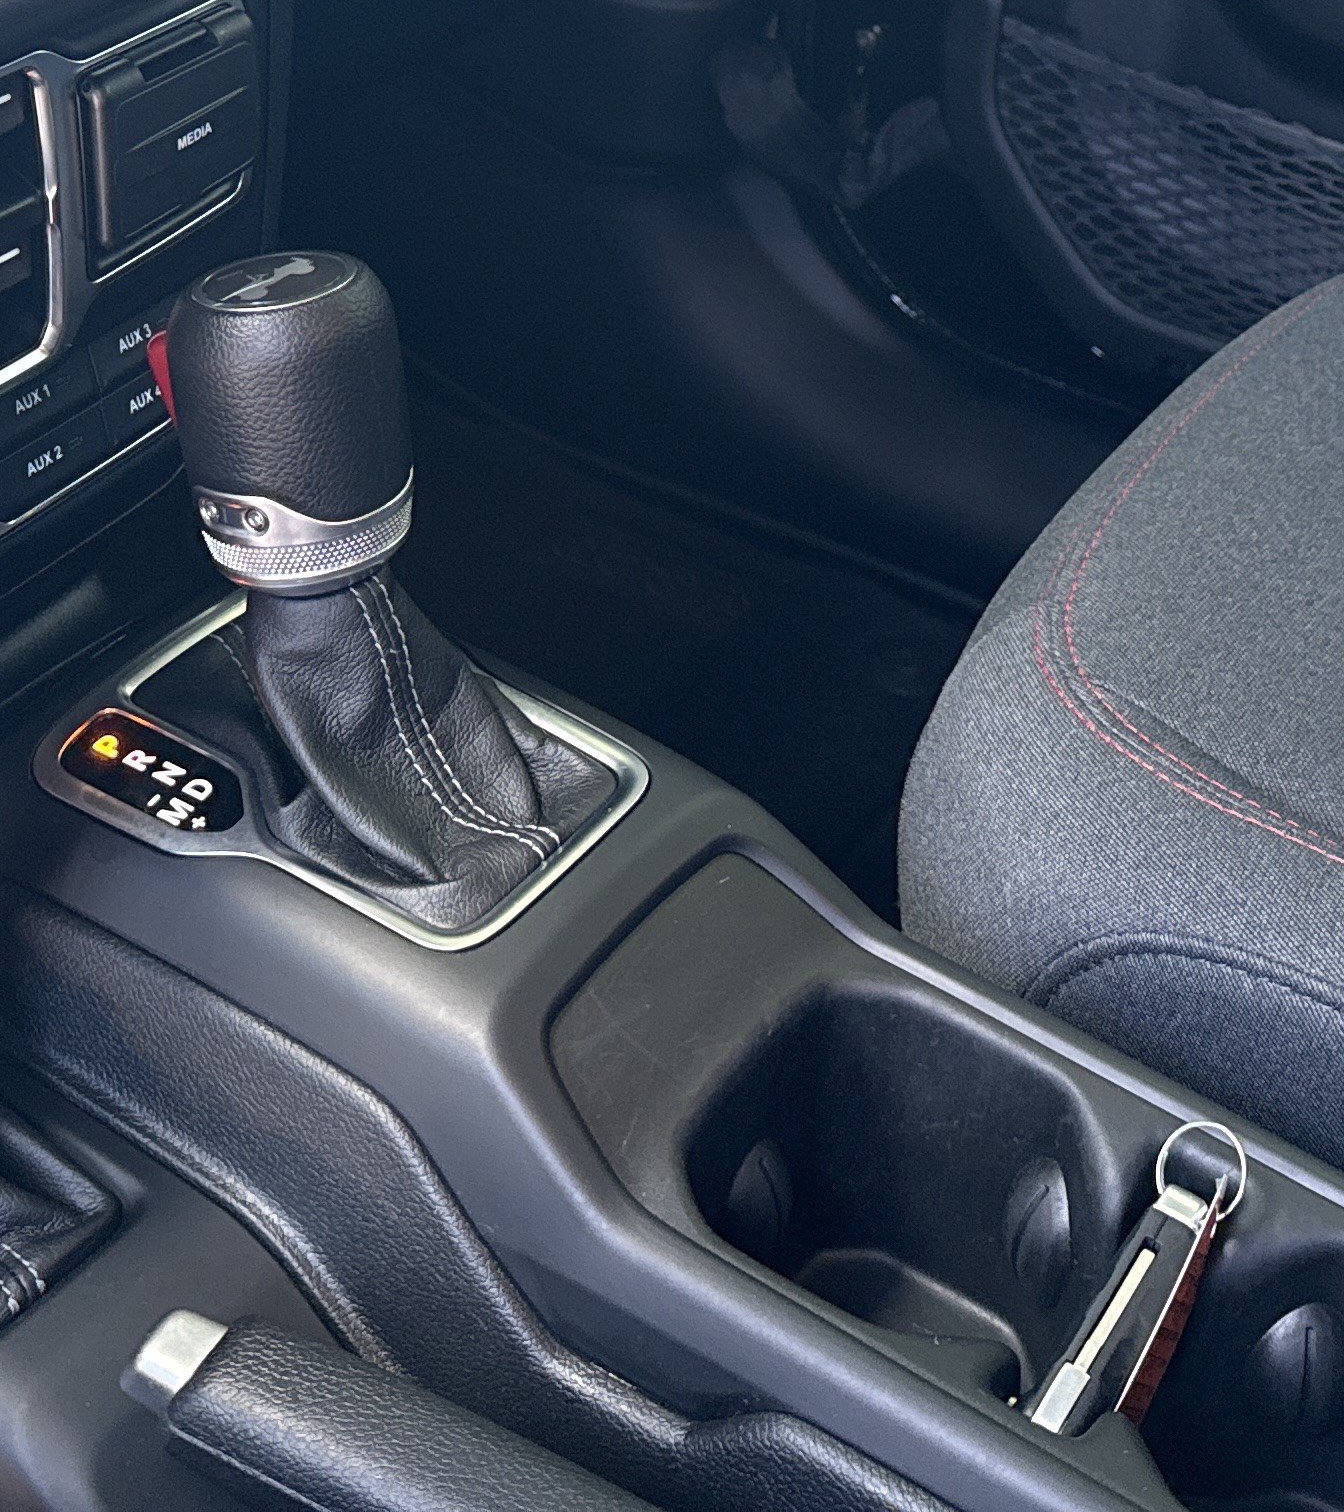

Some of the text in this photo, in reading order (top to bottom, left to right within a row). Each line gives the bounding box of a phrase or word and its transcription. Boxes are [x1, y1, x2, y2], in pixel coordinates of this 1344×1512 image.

[177, 122, 213, 152] MEDIA
[118, 324, 152, 355] AUX 3
[15, 389, 50, 415] AUX 1
[129, 390, 154, 414] AUX
[27, 444, 64, 477] AUX 2
[92, 734, 122, 759] P
[123, 750, 156, 772] R
[182, 779, 214, 802] D
